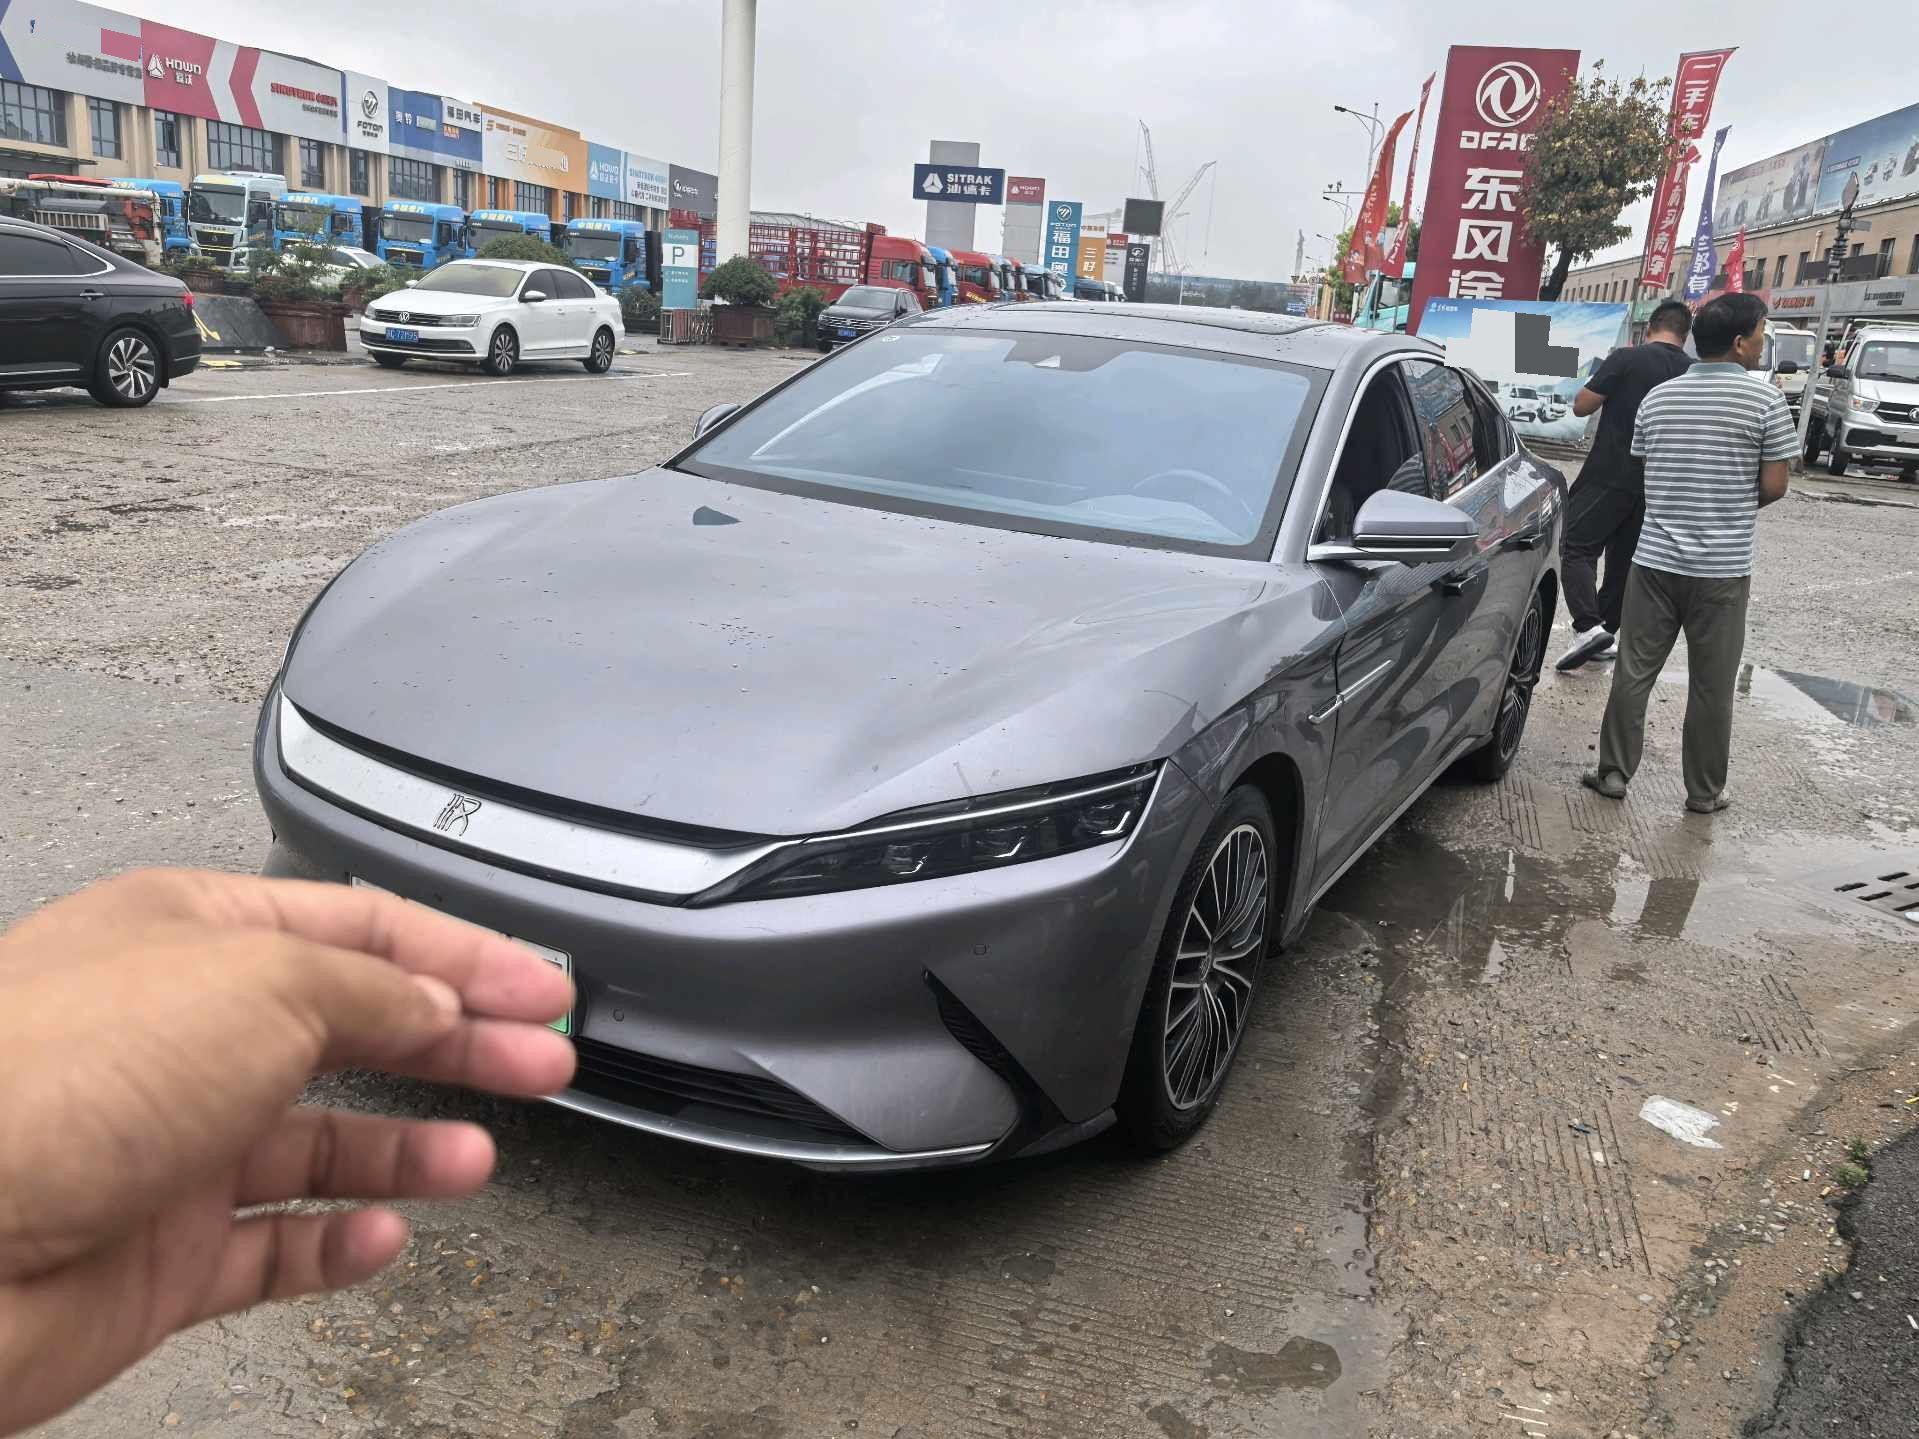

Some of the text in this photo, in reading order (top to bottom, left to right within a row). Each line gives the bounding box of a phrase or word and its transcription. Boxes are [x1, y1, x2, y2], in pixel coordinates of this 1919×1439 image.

[357, 120, 384, 134] FOTON
[946, 173, 993, 185] SITRAK
[672, 246, 685, 265] P
